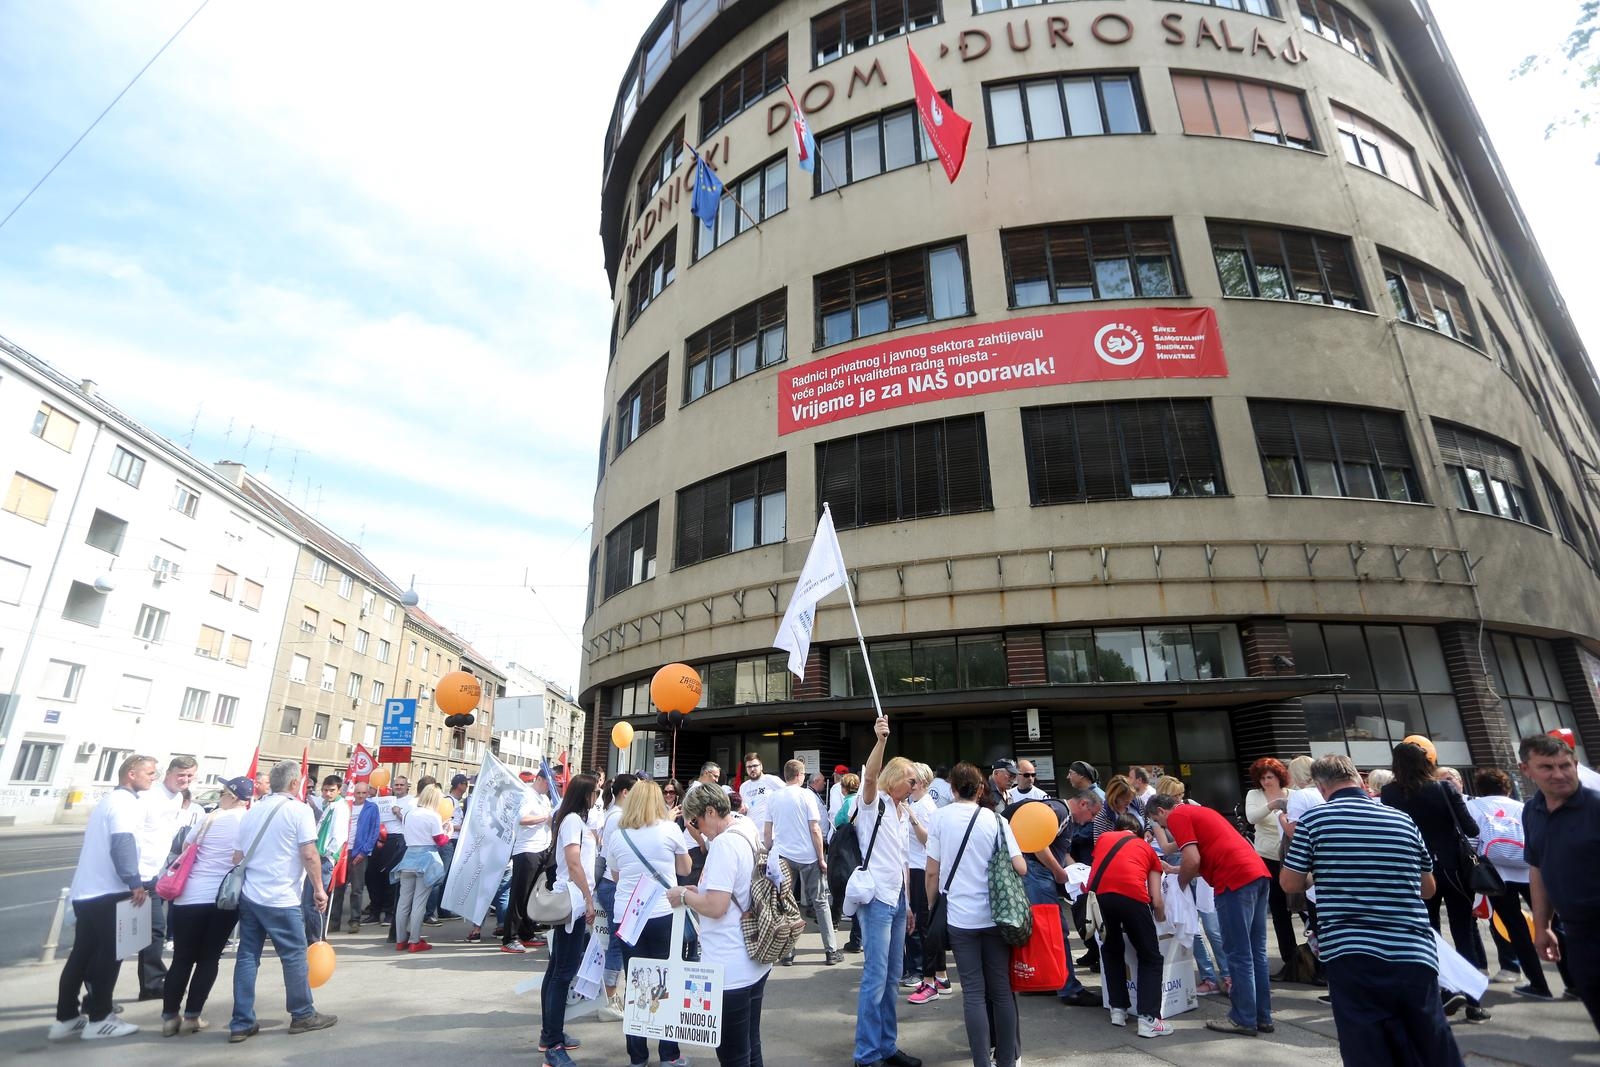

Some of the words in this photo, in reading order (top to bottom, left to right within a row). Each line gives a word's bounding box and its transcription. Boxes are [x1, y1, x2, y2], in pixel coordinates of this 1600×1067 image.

[767, 57, 888, 136] DOM
[792, 368, 828, 388] Radnici
[830, 356, 880, 379] privatnog
[883, 352, 887, 363] i
[889, 347, 927, 365] javnog
[930, 339, 975, 354] sektora
[978, 328, 1044, 346] zahtijevaju
[791, 387, 815, 401] veće
[817, 379, 845, 394] plaće
[847, 375, 851, 386] i
[853, 364, 908, 384] kvalitetna
[911, 358, 944, 372] radna
[947, 351, 989, 367] mjesta
[791, 393, 855, 421] Vrijeme
[858, 387, 876, 408] je
[881, 382, 902, 400] za
[907, 368, 949, 394] NAŠ
[954, 357, 1056, 389] oporavak!
[386, 701, 405, 725] P
[680, 1012, 706, 1027] GODINA
[707, 1015, 717, 1028] 70
[664, 1024, 674, 1038] SA
[675, 1026, 709, 1044] MIROVINU
[711, 1031, 717, 1044] U
